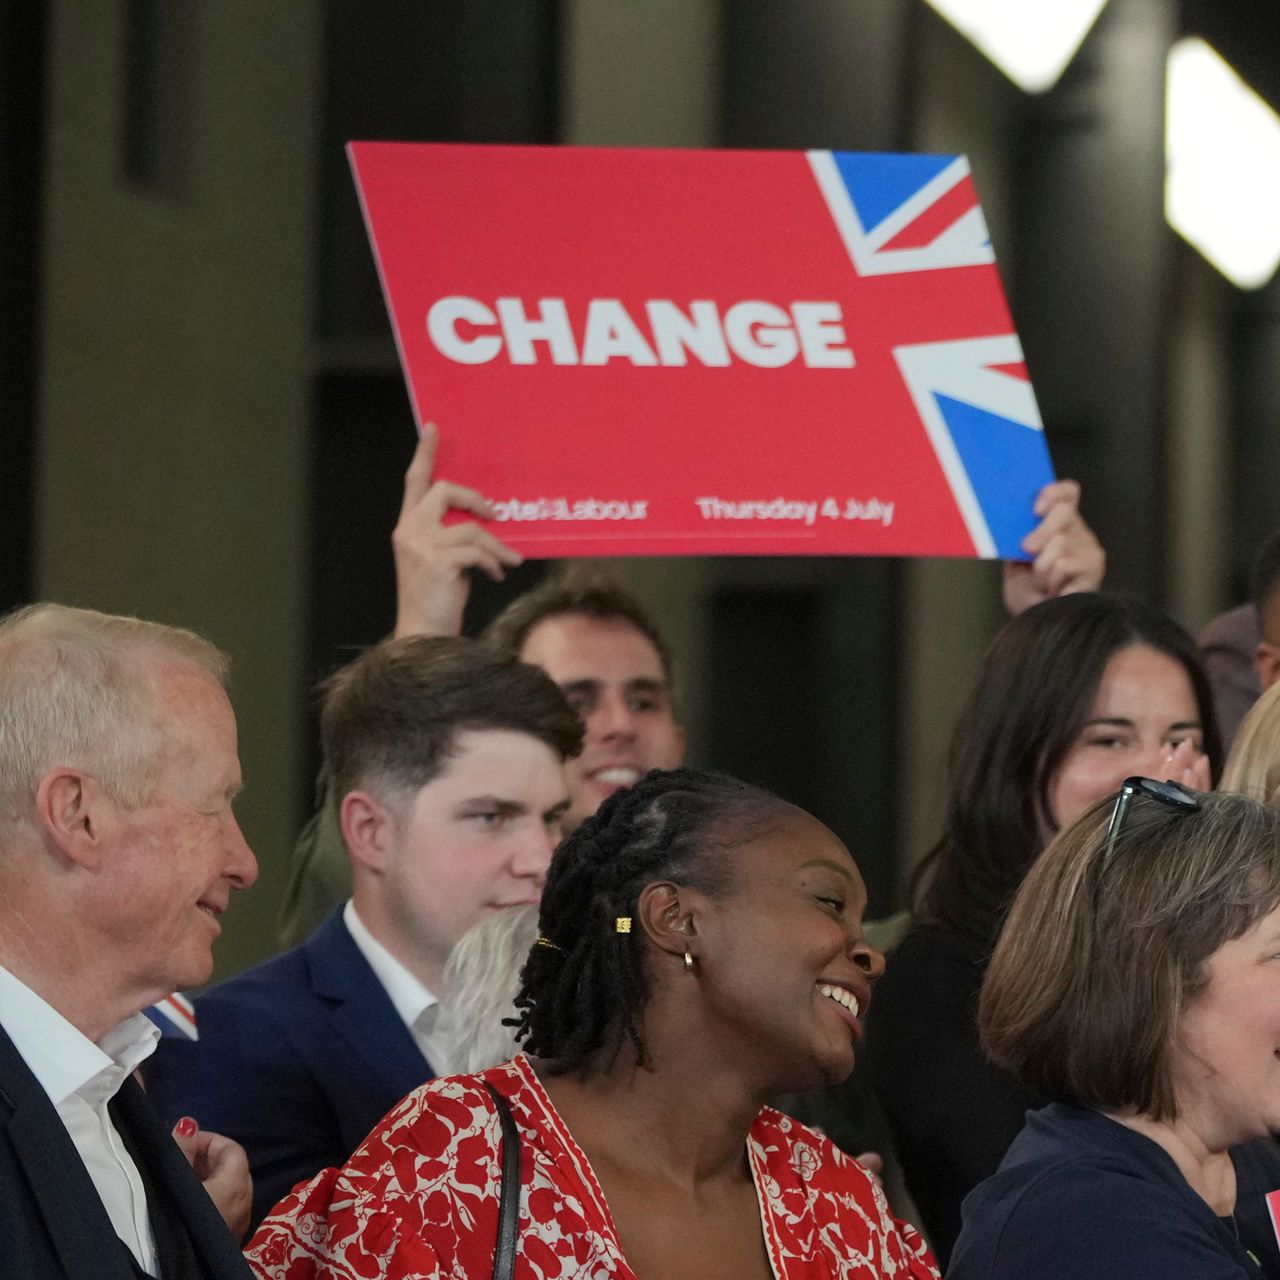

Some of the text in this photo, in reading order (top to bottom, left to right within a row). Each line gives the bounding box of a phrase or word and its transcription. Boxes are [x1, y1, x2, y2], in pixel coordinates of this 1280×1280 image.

[426, 295, 856, 369] CHANGE
[485, 497, 648, 522] ote Labour
[696, 496, 895, 526] Thursday 4 July
